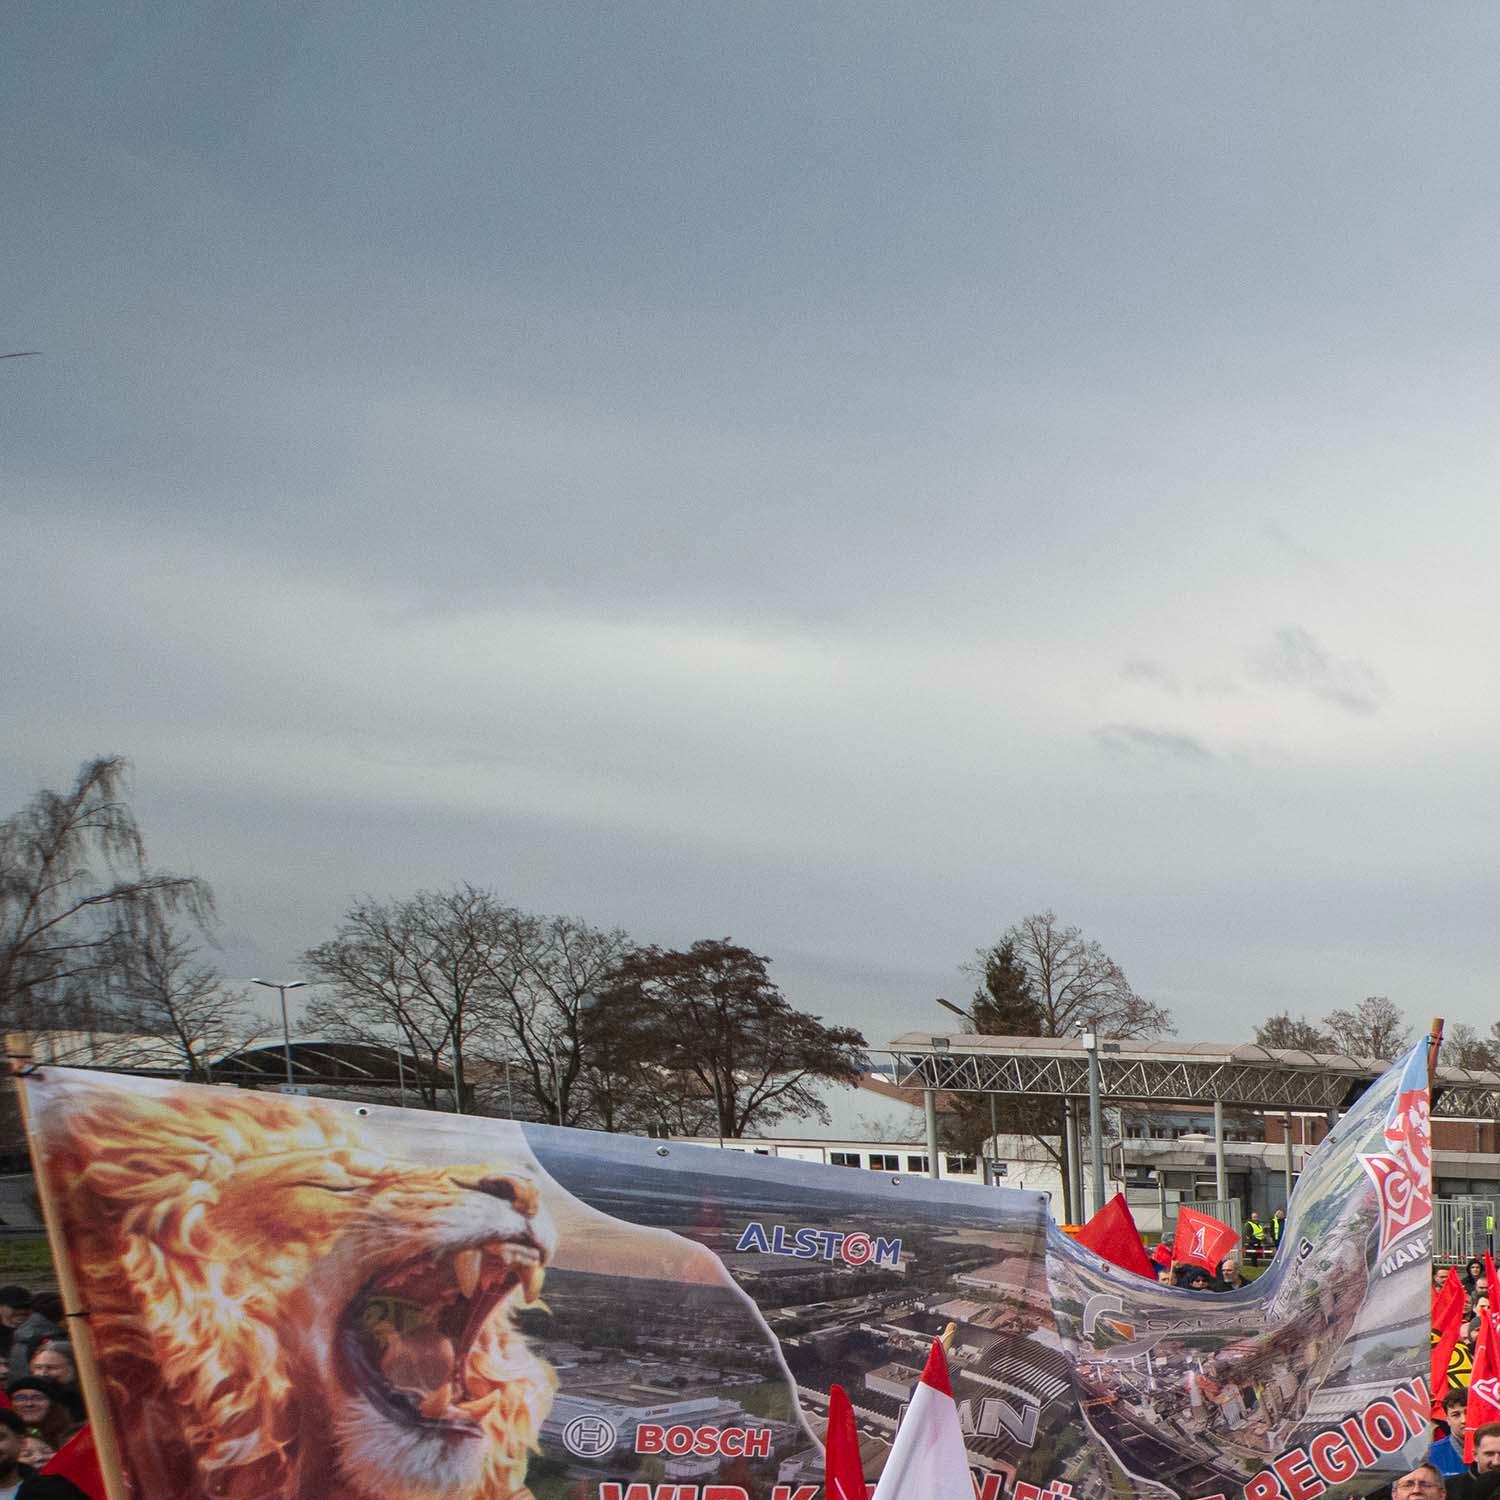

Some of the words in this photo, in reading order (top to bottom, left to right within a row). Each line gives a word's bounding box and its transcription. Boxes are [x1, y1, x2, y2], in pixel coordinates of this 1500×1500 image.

[736, 1222, 902, 1266] ALSTOM
[1380, 1238, 1428, 1278] MAN
[635, 1424, 772, 1458] BOSCH
